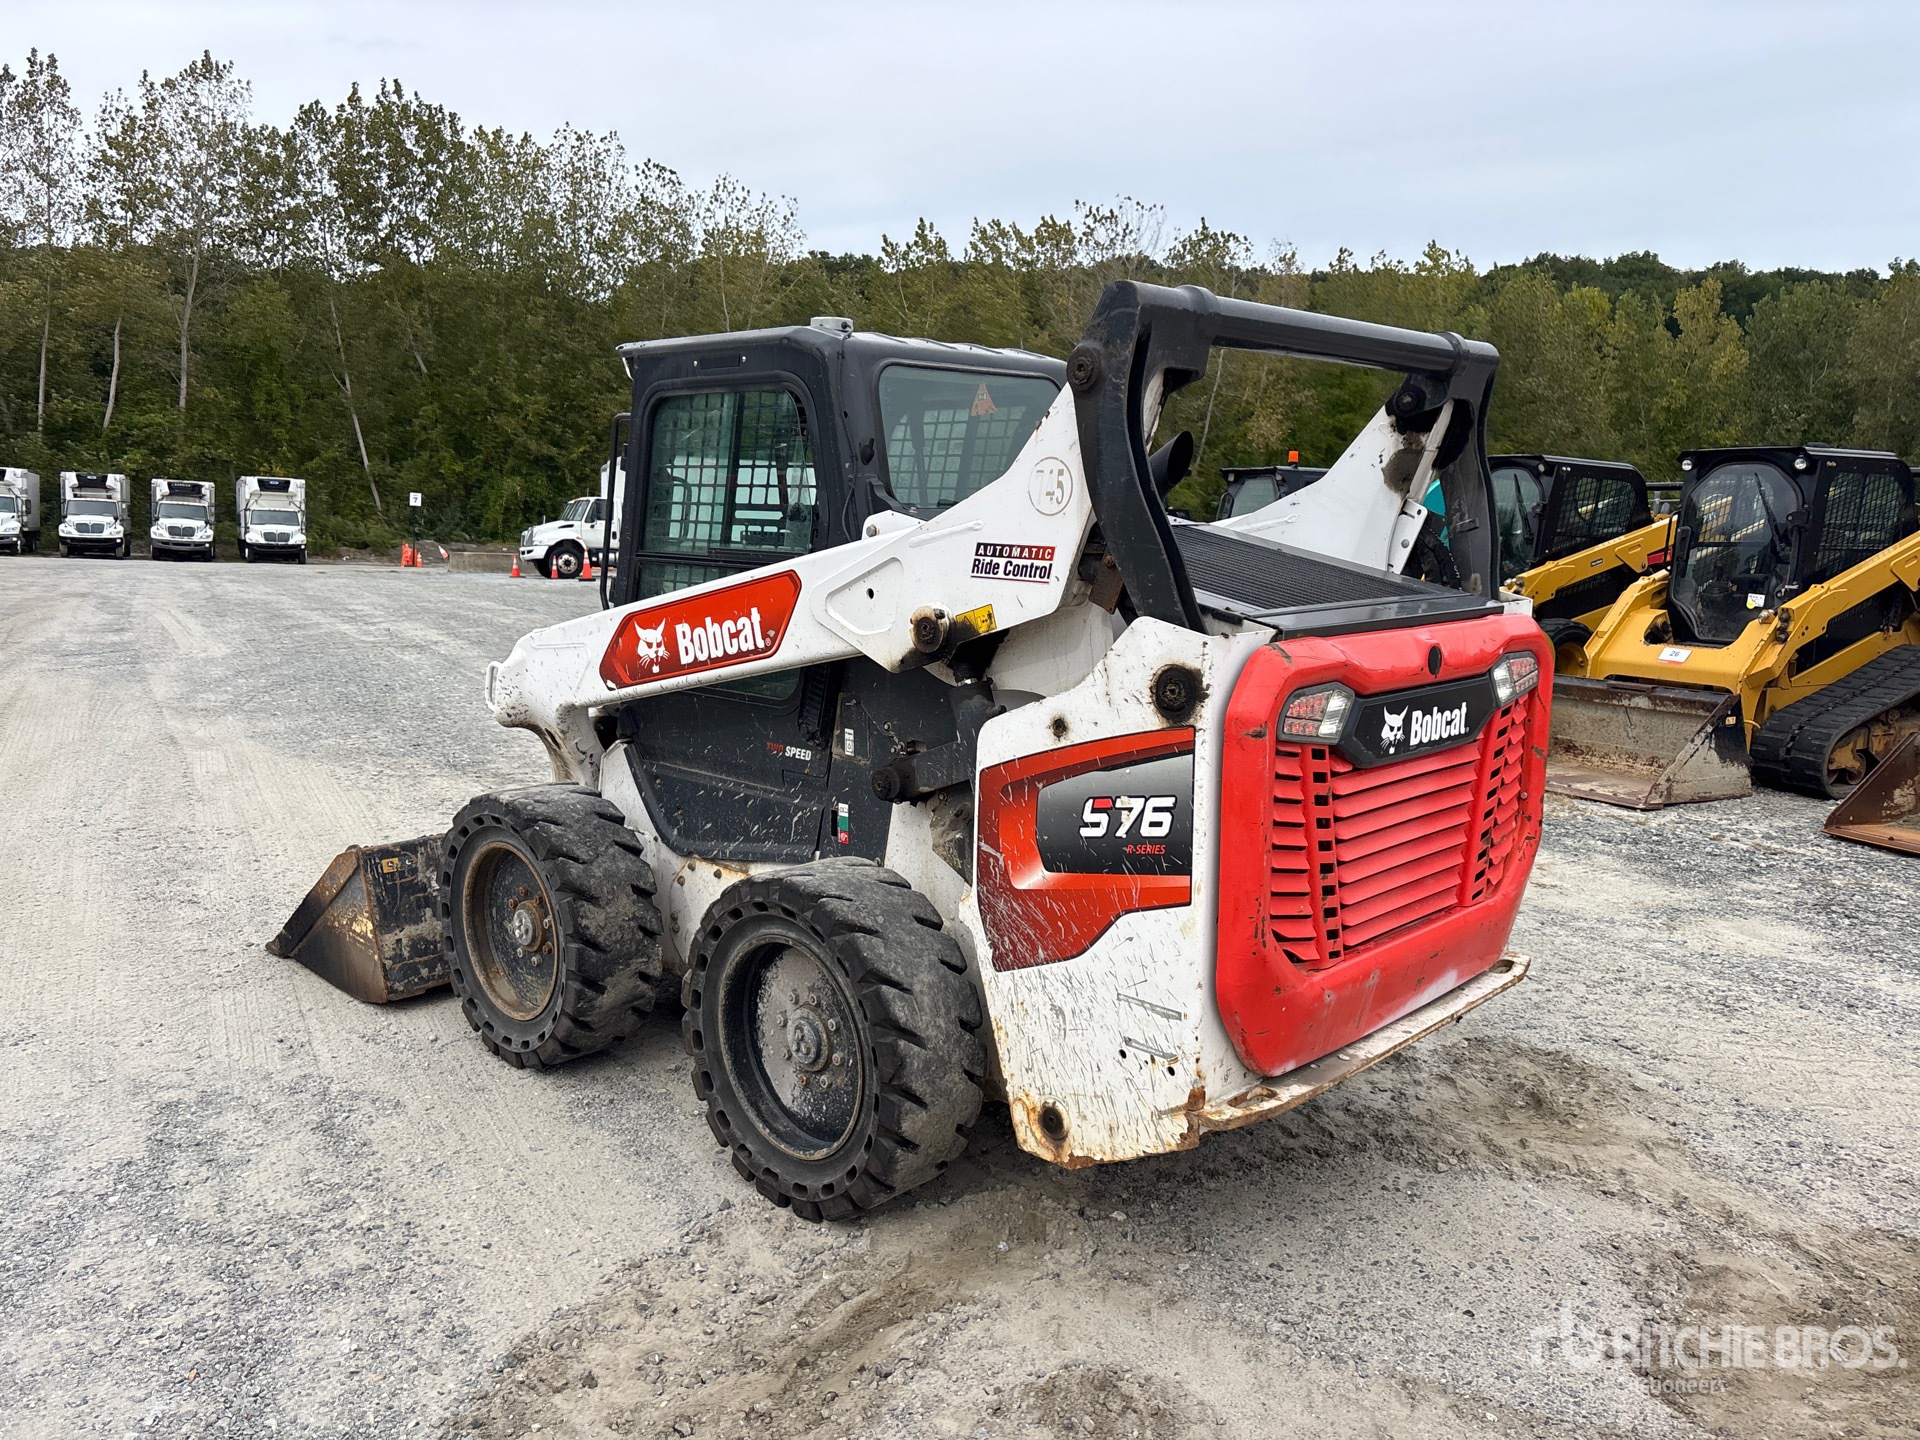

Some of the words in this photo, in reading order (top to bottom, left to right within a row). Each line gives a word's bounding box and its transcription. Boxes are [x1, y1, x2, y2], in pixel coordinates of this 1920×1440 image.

[977, 544, 1053, 560] AUTOMATIC
[971, 557, 1000, 576] Ride
[1003, 560, 1053, 580] Control
[675, 607, 765, 665] Bobcat
[1409, 701, 1468, 746] Bobcat
[785, 745, 812, 761] SPEED
[1079, 795, 1177, 838] S76
[1125, 844, 1166, 855] R-SERIES
